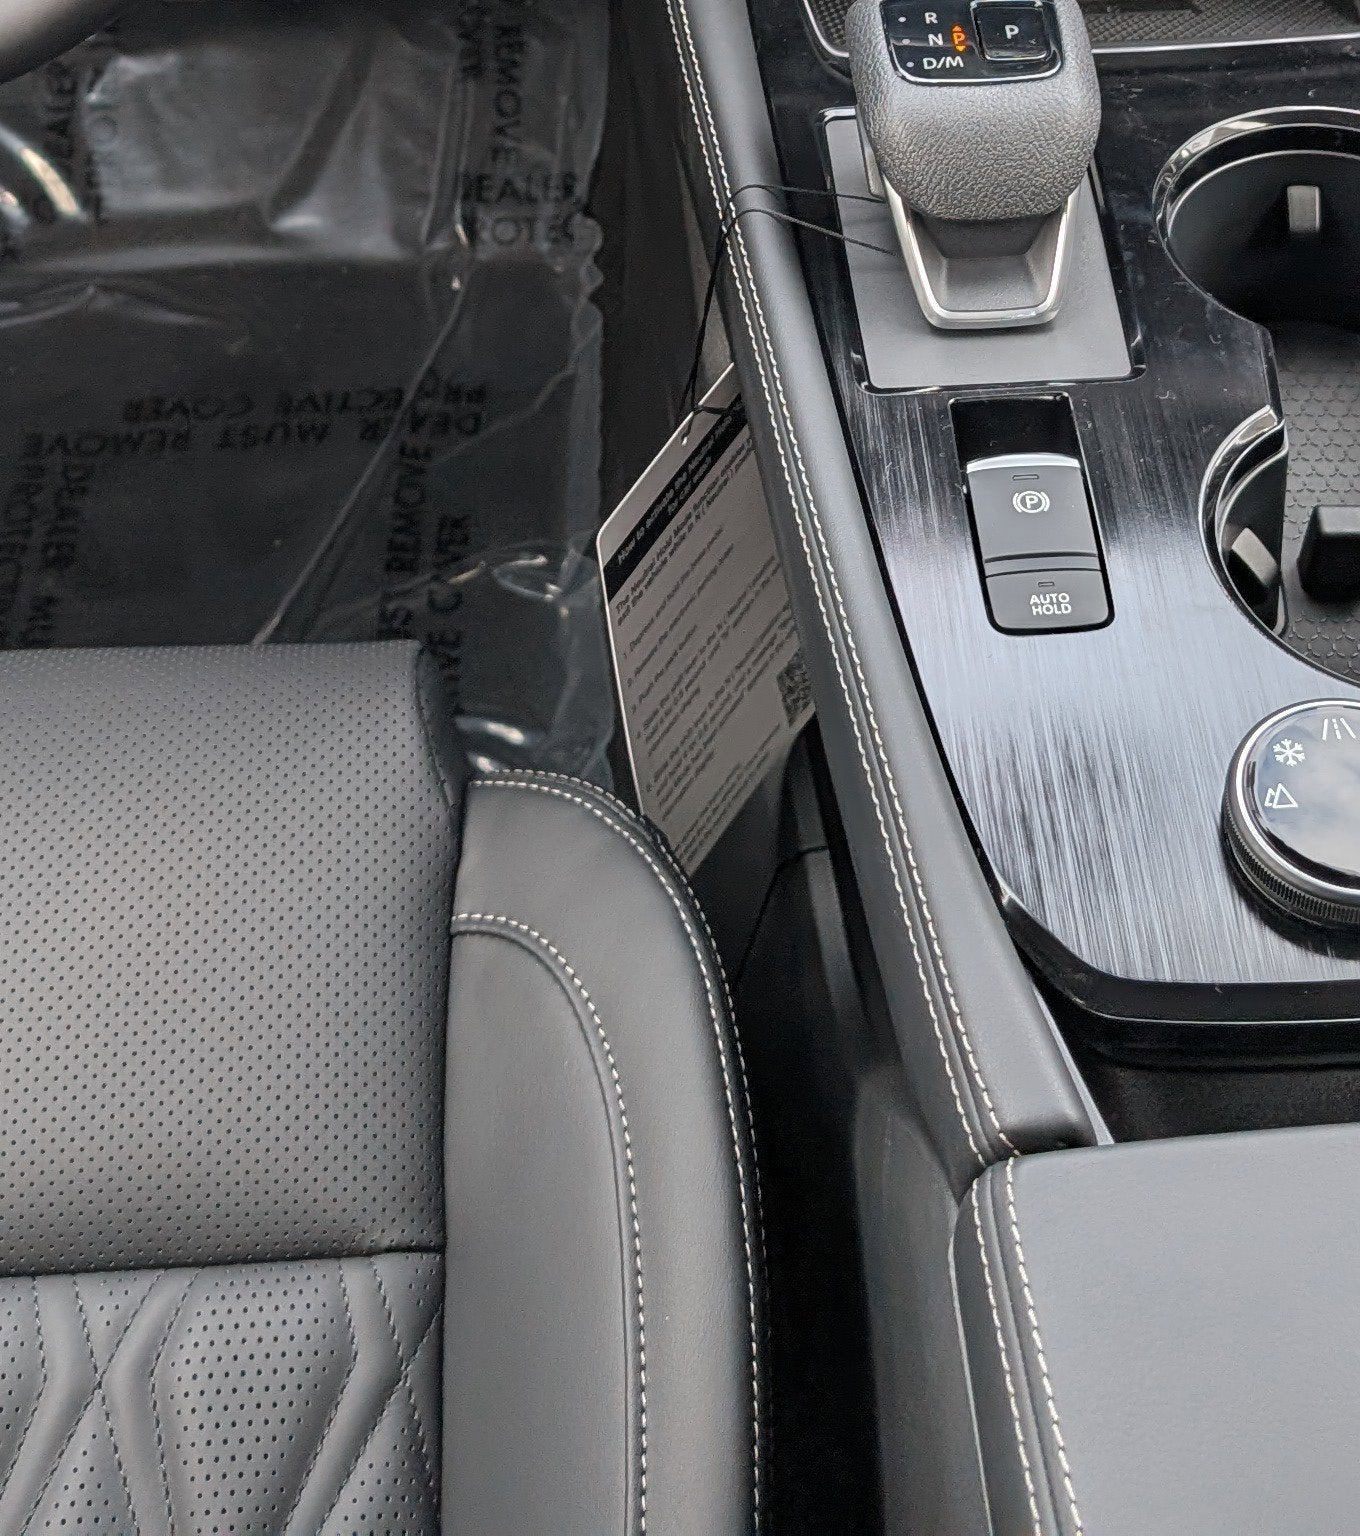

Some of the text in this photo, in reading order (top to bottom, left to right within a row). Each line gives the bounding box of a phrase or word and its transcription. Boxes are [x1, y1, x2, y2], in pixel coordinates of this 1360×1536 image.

[924, 11, 939, 26] R
[928, 31, 966, 47] N P
[1004, 24, 1020, 41] P
[922, 53, 965, 70] D/M
[1029, 593, 1070, 606] AUTO
[1031, 602, 1072, 616] HOLD
